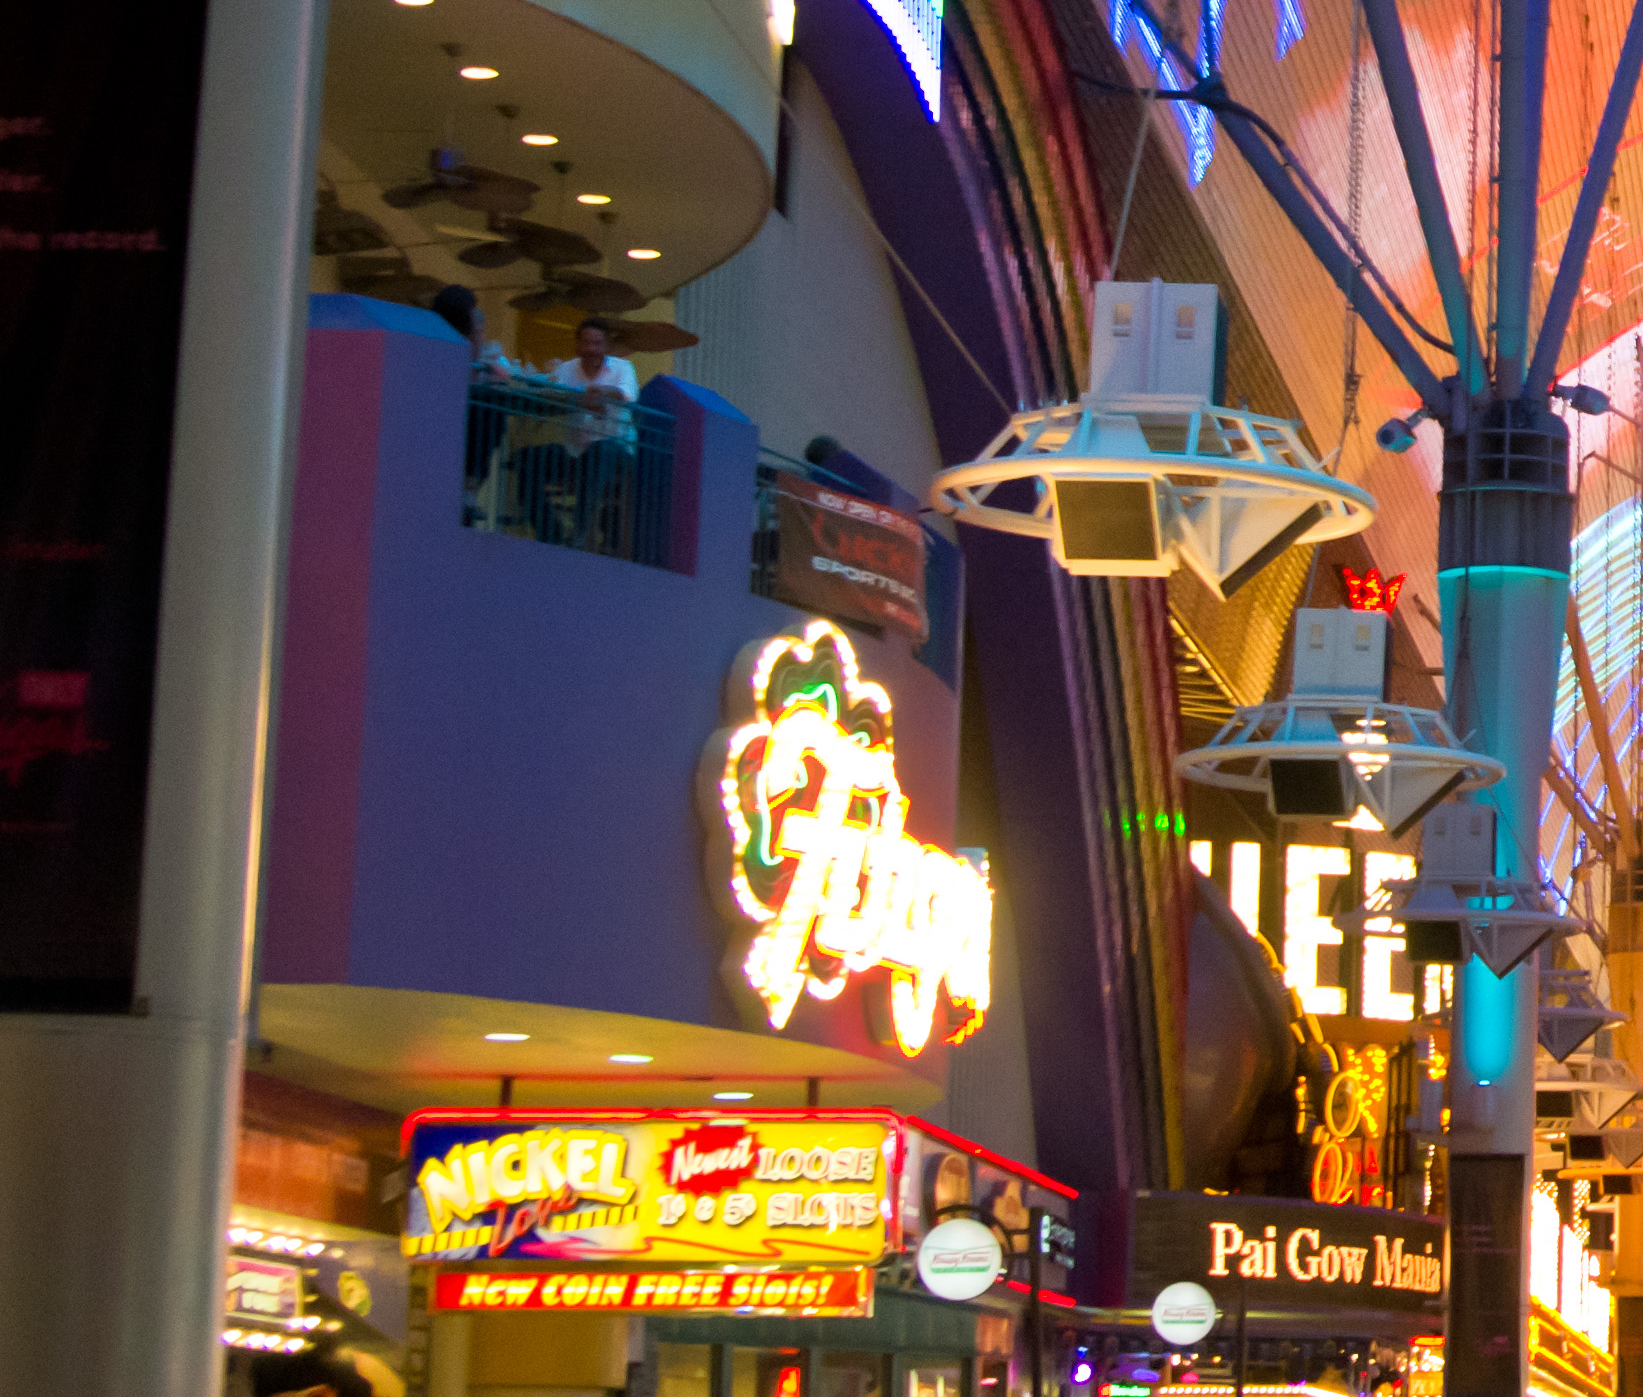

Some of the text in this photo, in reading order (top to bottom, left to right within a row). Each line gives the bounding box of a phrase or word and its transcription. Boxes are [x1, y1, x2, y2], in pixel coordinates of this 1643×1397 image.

[418, 1128, 637, 1233] NICKEL
[669, 1134, 877, 1186] Newest LOOSE
[766, 1192, 878, 1227] SLOTS
[1208, 1222, 1278, 1279] Pai
[1284, 1227, 1369, 1284] Gow
[1372, 1234, 1442, 1293] Mania
[459, 1274, 542, 1306] New
[540, 1274, 627, 1306] COIN
[630, 1274, 725, 1307] FREE
